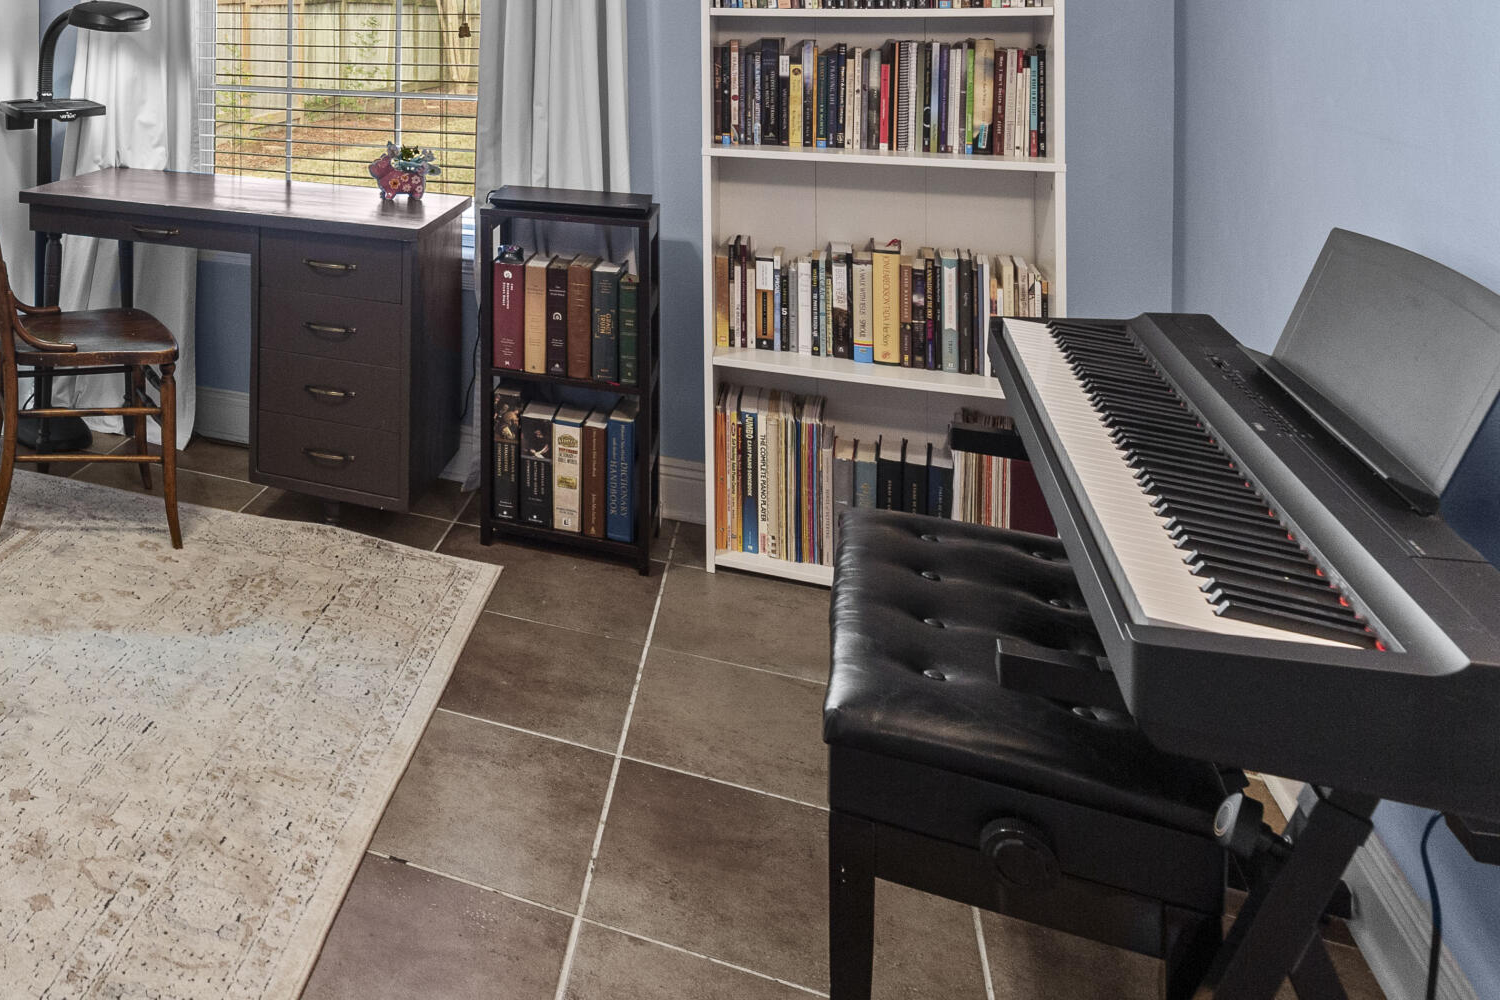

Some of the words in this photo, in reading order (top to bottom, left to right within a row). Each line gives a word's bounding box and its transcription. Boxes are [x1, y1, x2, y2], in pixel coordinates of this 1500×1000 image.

[859, 319, 867, 338] SPROUL
[883, 323, 891, 333] Her
[745, 413, 754, 439] JUMBO
[759, 434, 767, 446] THE
[759, 446, 767, 479] COMPLETE
[609, 460, 618, 516] HANDBOOK
[620, 462, 629, 518] DICTIONARY
[759, 479, 767, 500] PIANO
